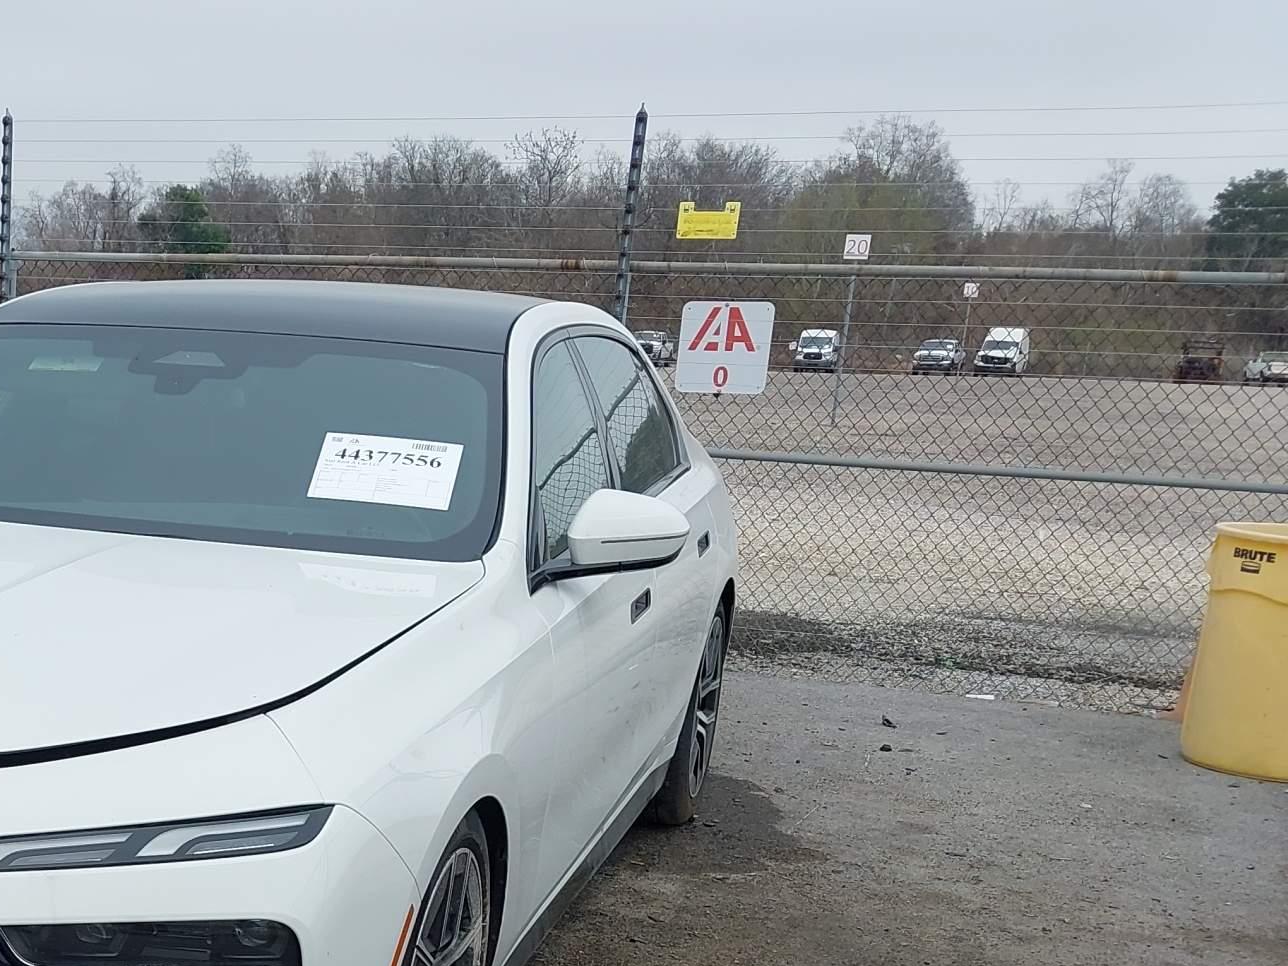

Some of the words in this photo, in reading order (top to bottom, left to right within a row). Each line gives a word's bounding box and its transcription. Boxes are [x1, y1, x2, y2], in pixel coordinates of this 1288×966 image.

[846, 239, 868, 255] 20
[713, 366, 729, 388] 0
[334, 447, 442, 468] 44377556
[1233, 546, 1277, 564] BRUTE
